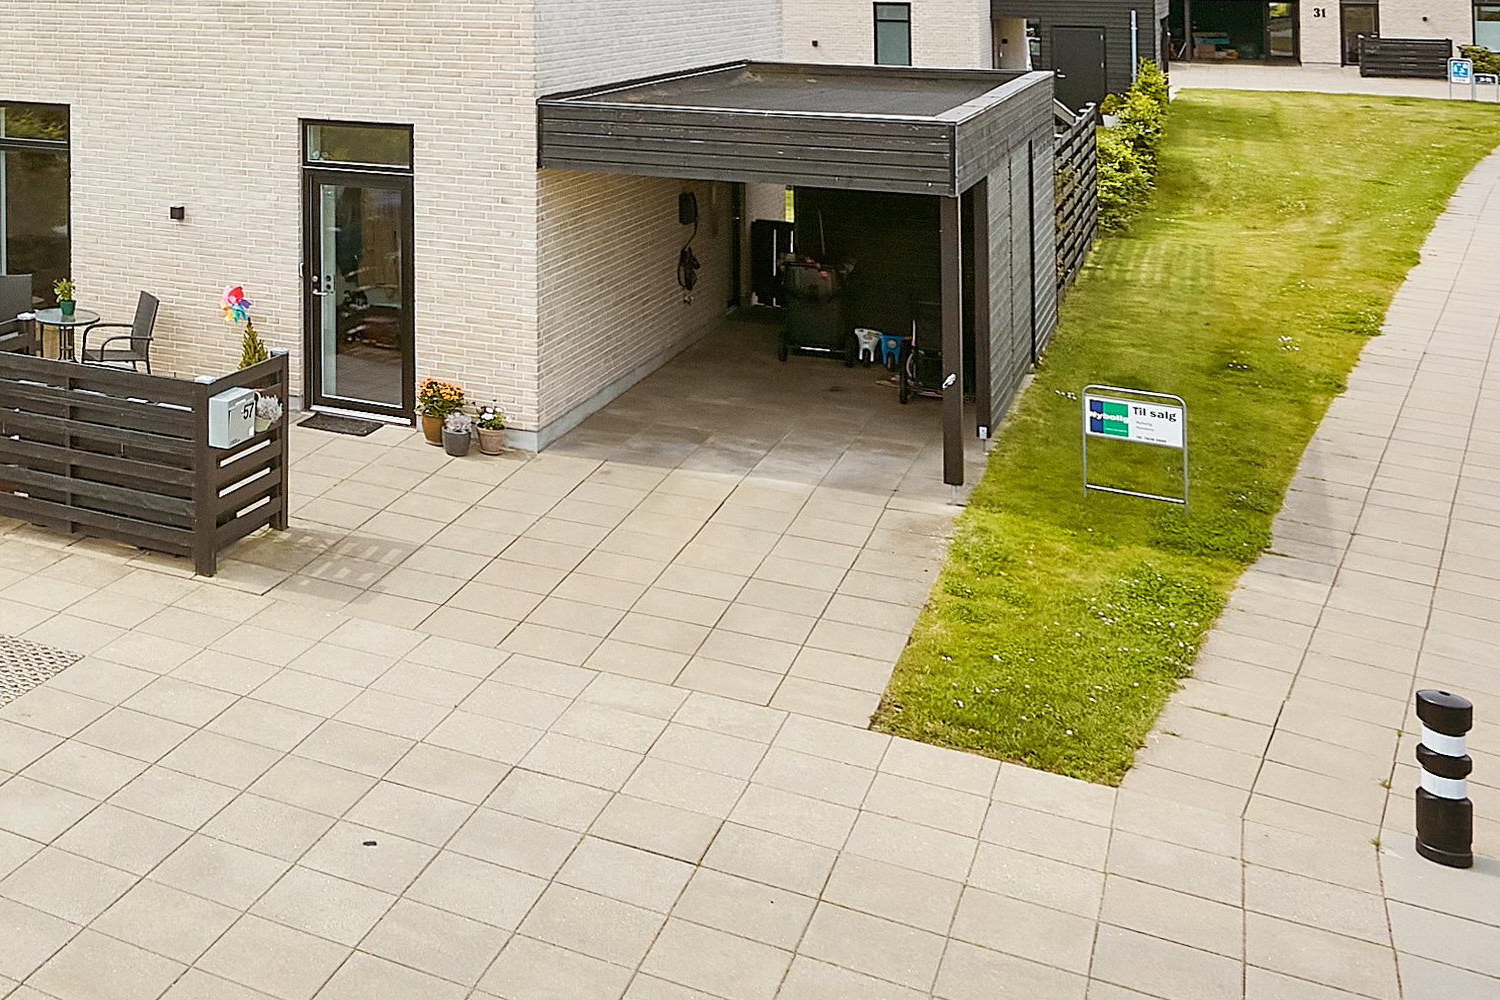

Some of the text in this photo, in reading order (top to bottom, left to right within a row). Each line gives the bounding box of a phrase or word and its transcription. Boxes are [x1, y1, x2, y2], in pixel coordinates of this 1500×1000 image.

[1313, 7, 1326, 18] 31
[243, 401, 255, 420] 57
[1132, 406, 1177, 422] Til salg
